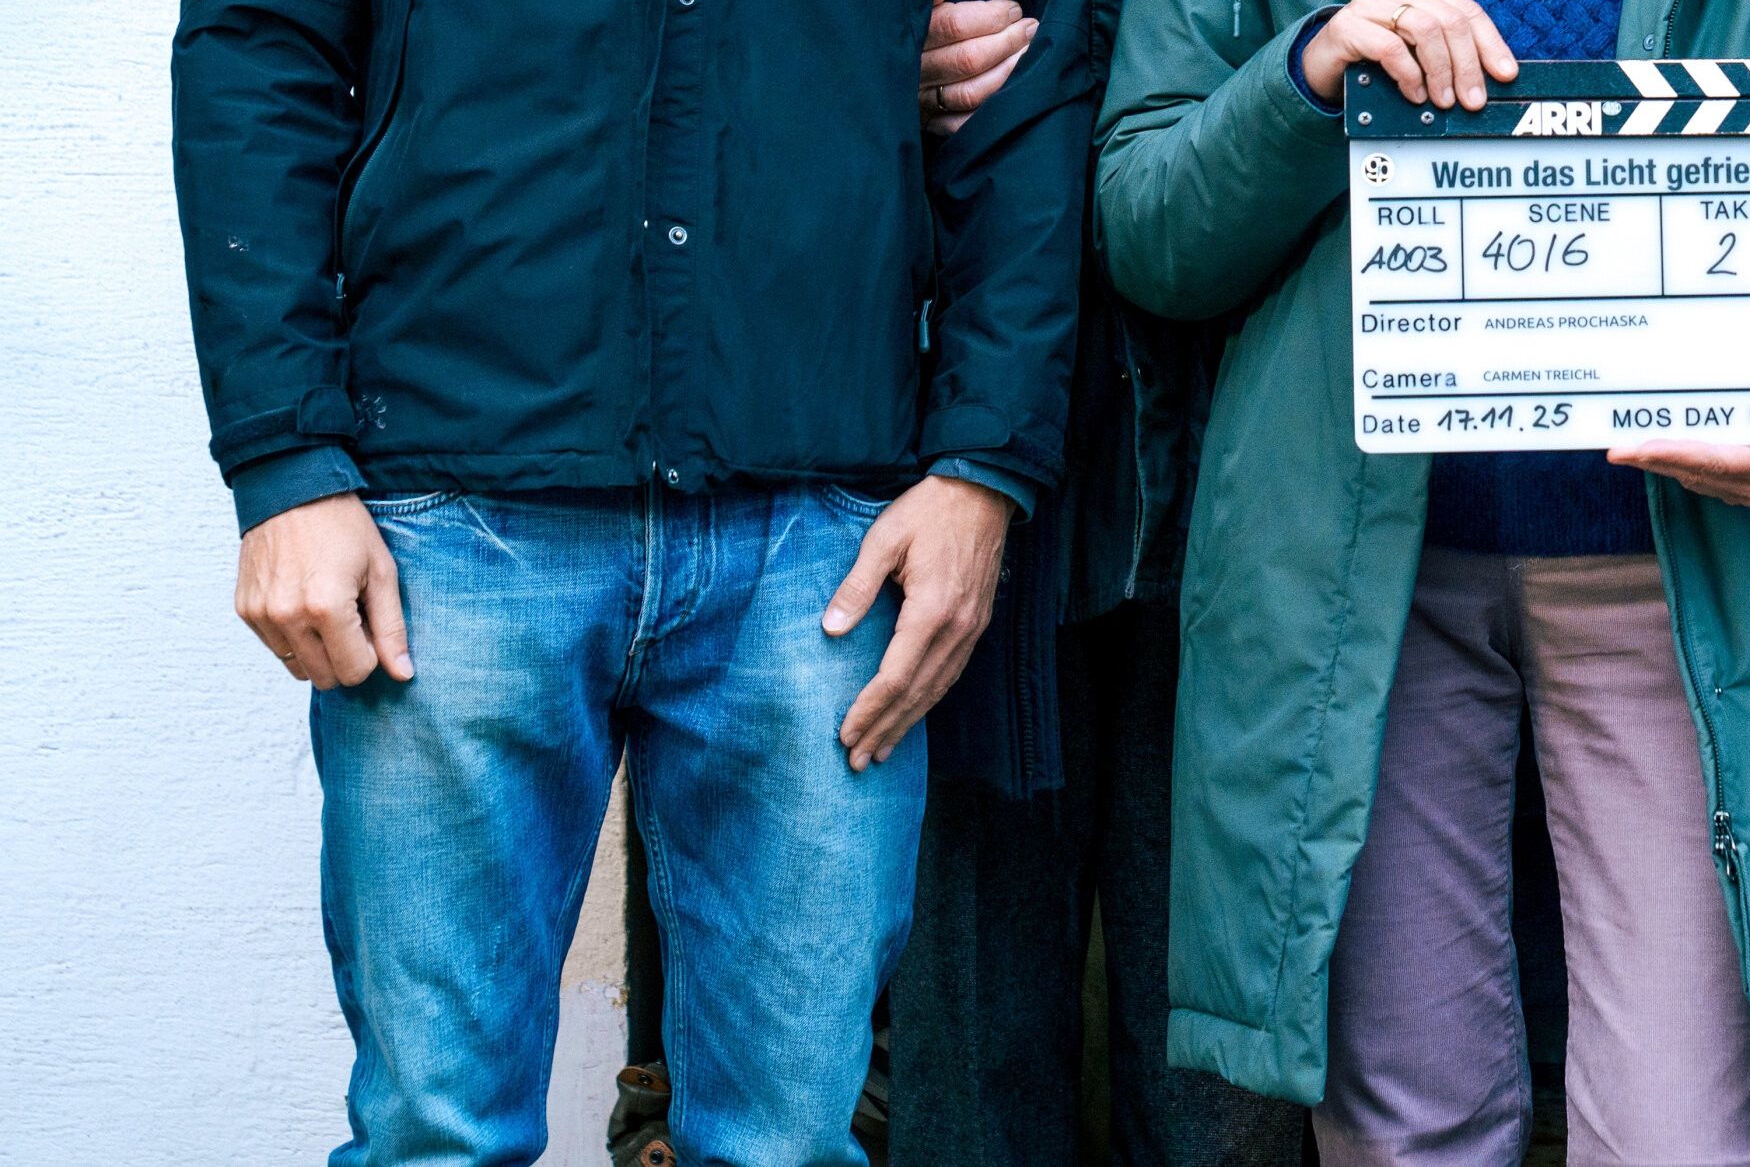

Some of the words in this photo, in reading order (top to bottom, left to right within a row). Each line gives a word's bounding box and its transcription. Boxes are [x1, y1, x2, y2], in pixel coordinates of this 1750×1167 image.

[1511, 101, 1602, 136] ARRI
[1431, 160, 1512, 188] Wenn
[1523, 159, 1575, 187] das
[1585, 158, 1657, 186] Licht
[1377, 206, 1445, 226] ROLL
[1528, 202, 1611, 223] SCENE
[1360, 243, 1448, 274] A003
[1706, 232, 1737, 276] 2
[1361, 313, 1462, 333] Director
[1484, 316, 1555, 330] ANDREAS
[1558, 314, 1649, 329] PROCHASKA
[1362, 369, 1458, 389] Camera
[1483, 370, 1541, 382] CARMEN
[1545, 368, 1601, 381] TREICHL
[1362, 414, 1421, 434] Date
[1612, 407, 1672, 428] MOS
[1685, 406, 1735, 427] DAY
